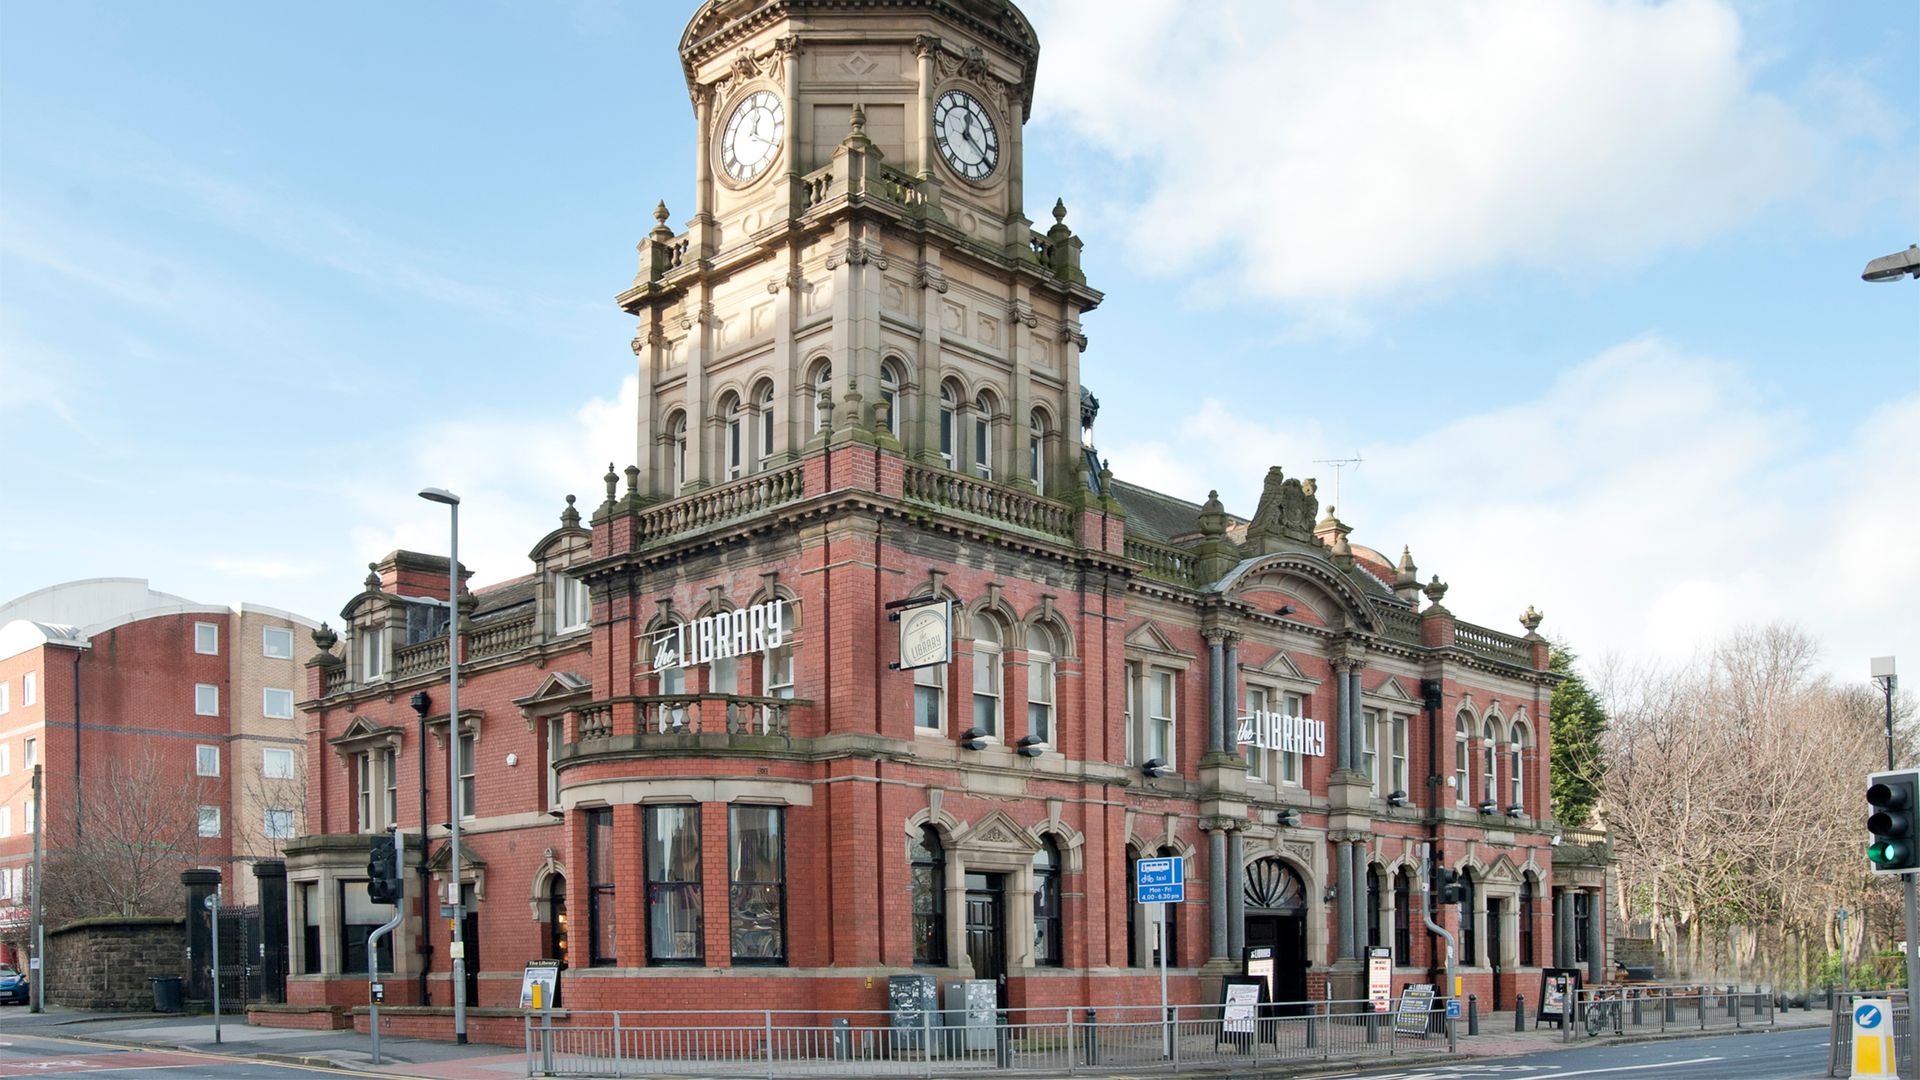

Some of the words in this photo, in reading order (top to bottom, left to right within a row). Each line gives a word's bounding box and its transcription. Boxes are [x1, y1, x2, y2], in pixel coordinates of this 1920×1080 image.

[653, 633, 677, 670] the
[678, 599, 782, 667] LIBRARY
[911, 633, 942, 659] LIBRARY
[1236, 716, 1256, 742] the
[1256, 709, 1325, 757] LIBRARY
